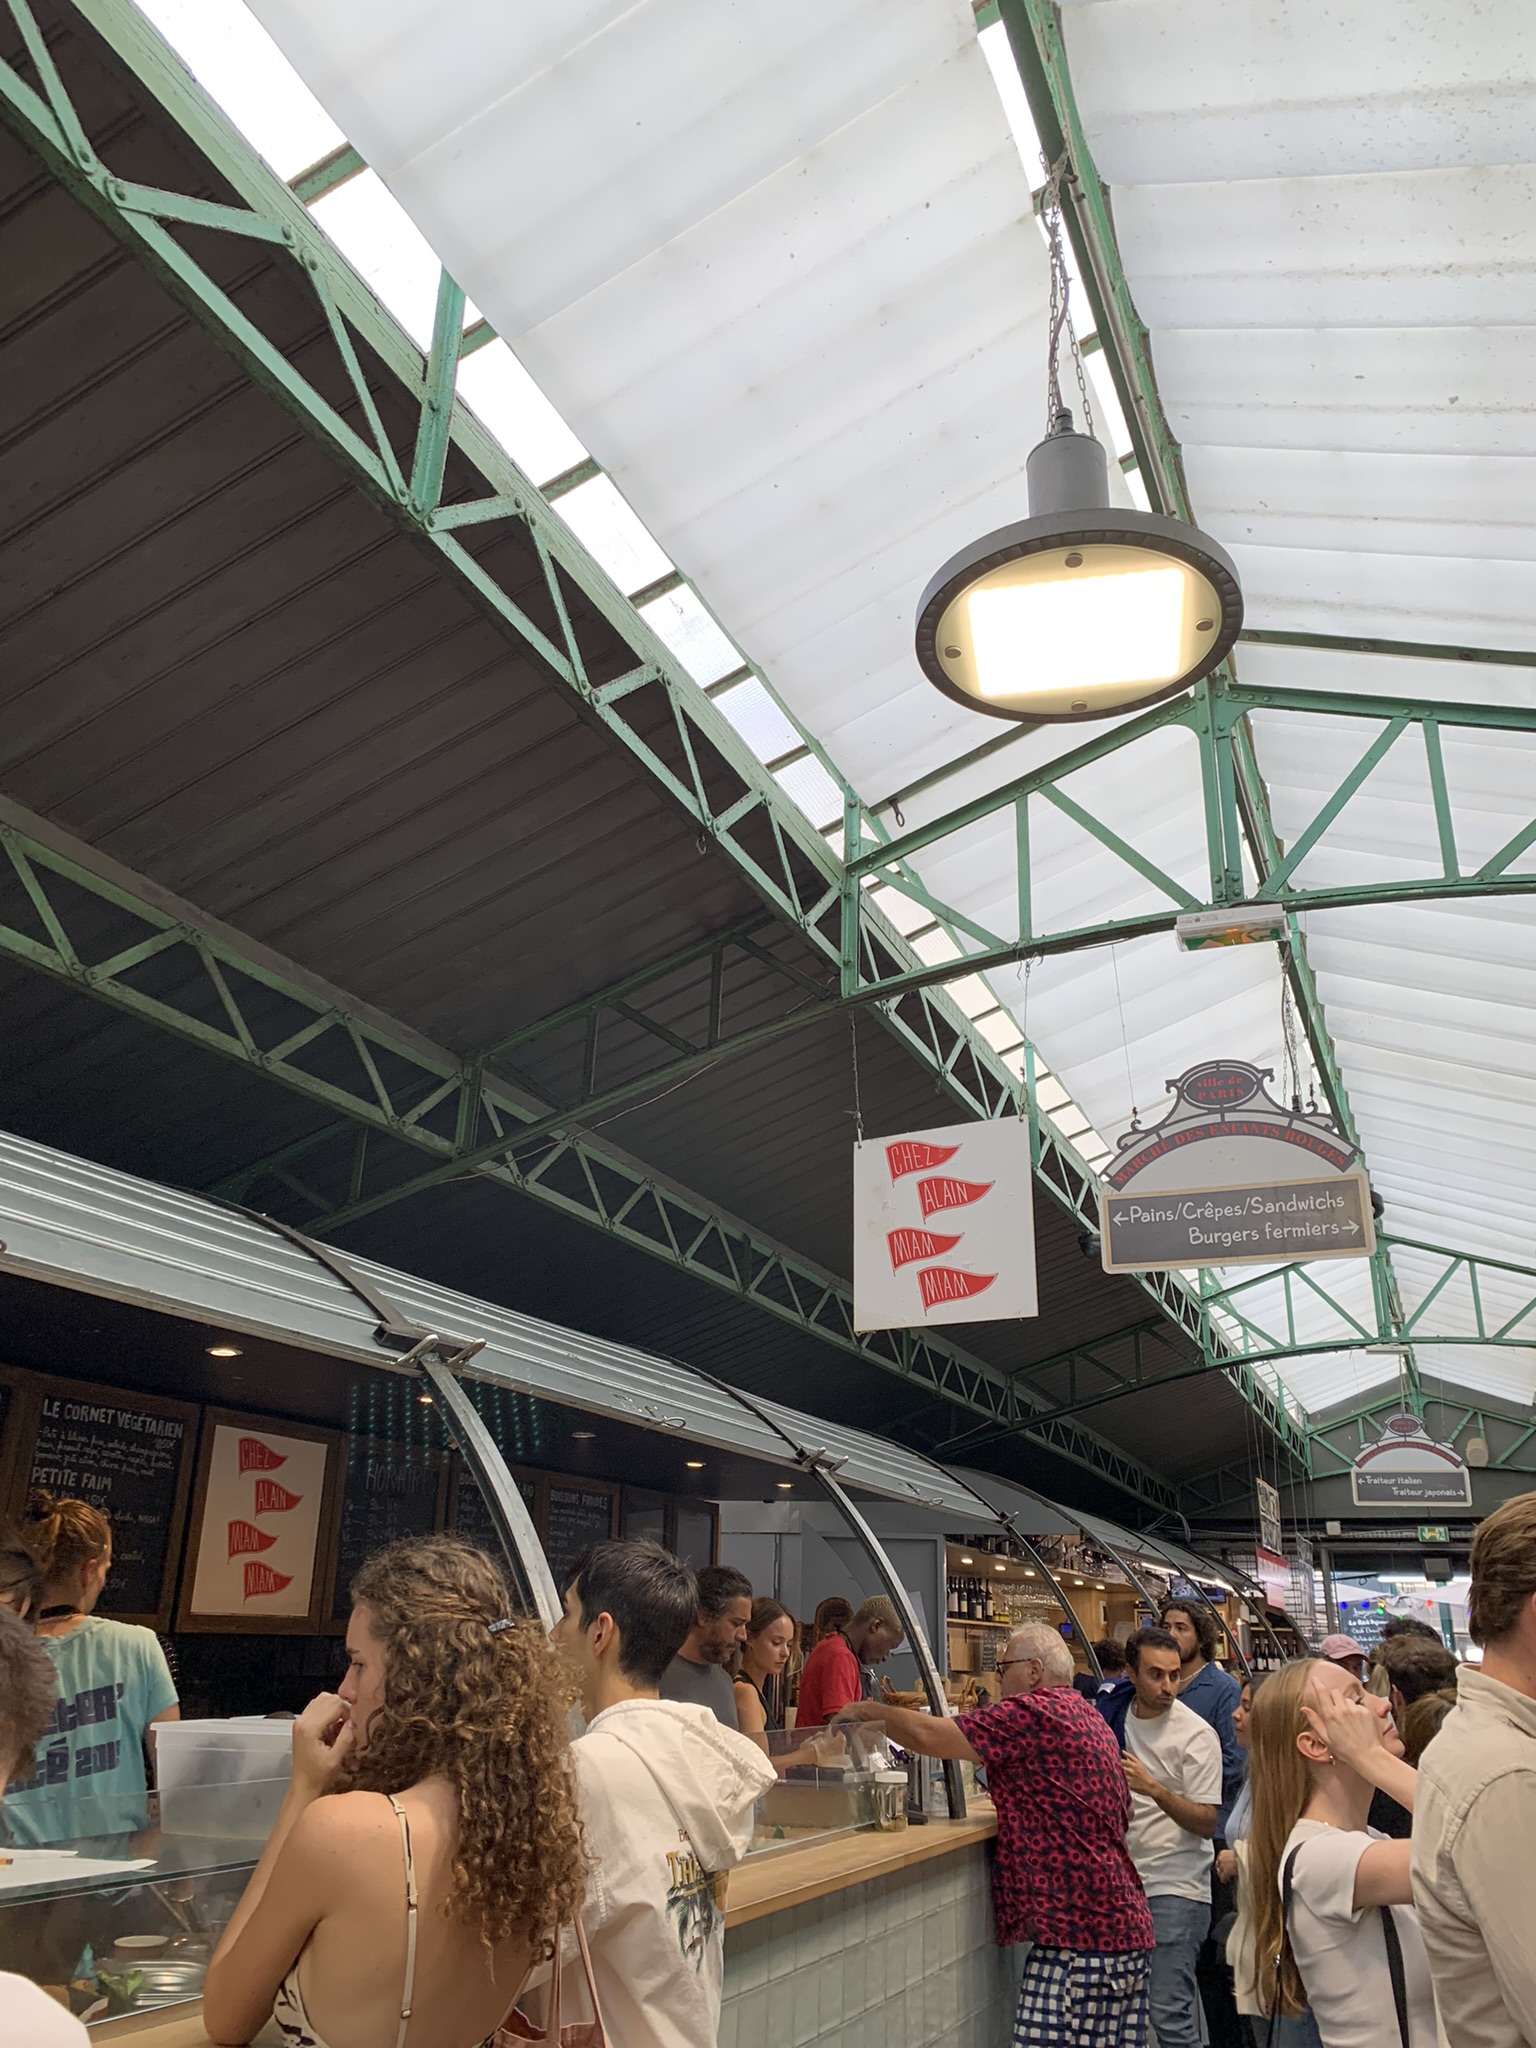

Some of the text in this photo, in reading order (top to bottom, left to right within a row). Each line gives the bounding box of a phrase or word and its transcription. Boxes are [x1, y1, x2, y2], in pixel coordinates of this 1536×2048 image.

[1227, 1076, 1243, 1085] de
[1197, 1088, 1245, 1101] PARIS
[891, 1143, 934, 1175] CHEZ
[1115, 1123, 1346, 1186] MARCHÉ DES ENFANTS ROUGES
[923, 1180, 969, 1213] ALAIN
[1188, 1221, 1340, 1247] Burgers fermiers
[893, 1231, 936, 1265] MIAM
[924, 1270, 970, 1304] MIAM
[43, 1399, 184, 1438] LE CORNET VÉGÉTARIEN
[241, 1441, 270, 1468] CHEZ
[31, 1466, 112, 1491] PETITE FAIM
[1365, 1475, 1396, 1485] Traiteur
[1392, 1487, 1423, 1497] Traiteur
[257, 1482, 287, 1509] ALAIN
[230, 1523, 260, 1553] MIAM
[247, 1567, 275, 1594] MIAM
